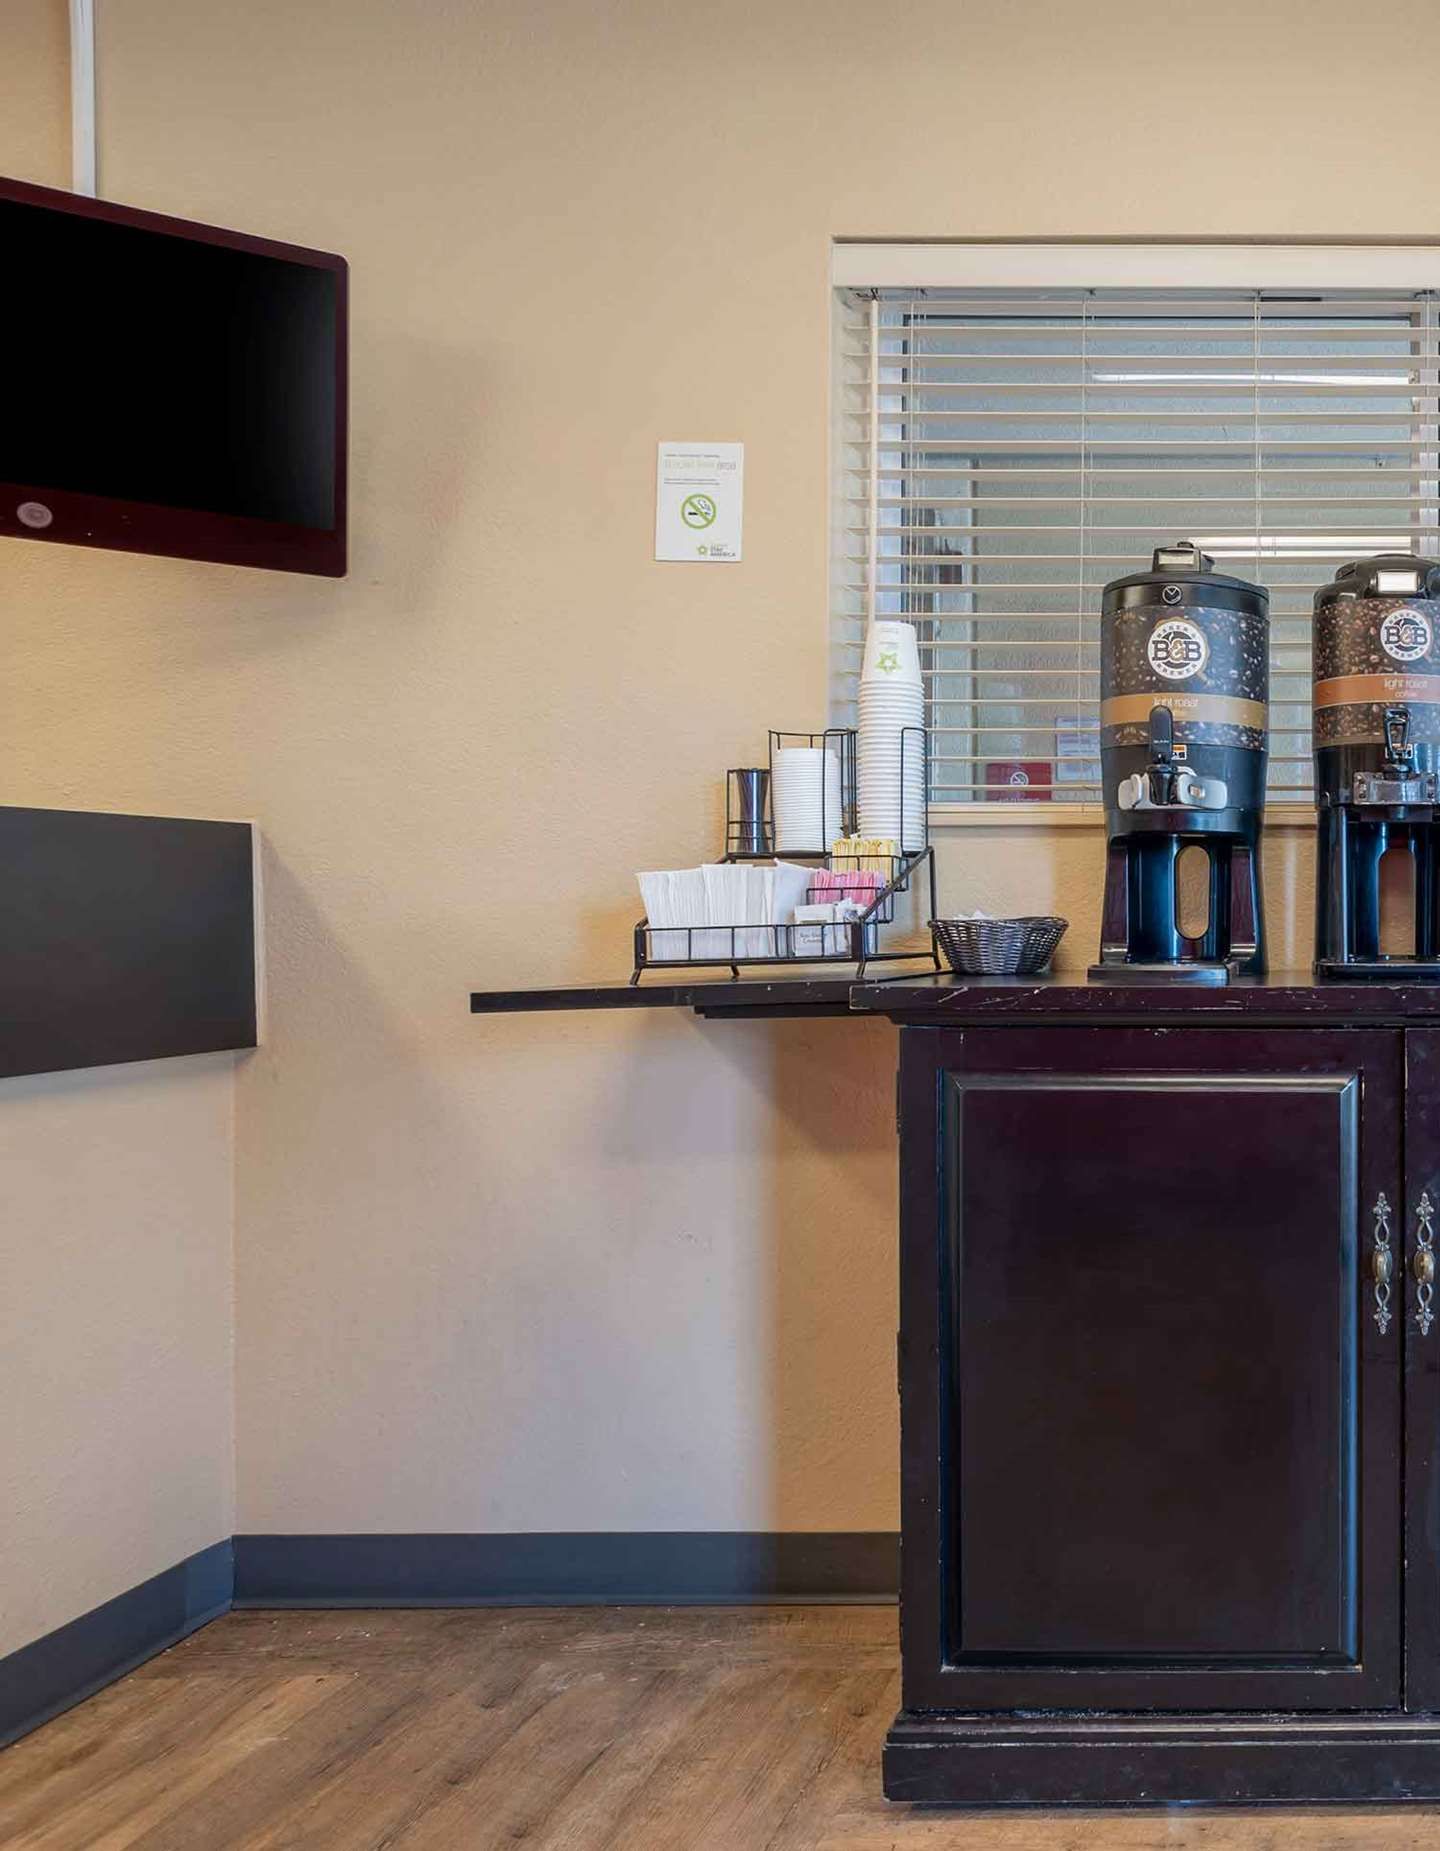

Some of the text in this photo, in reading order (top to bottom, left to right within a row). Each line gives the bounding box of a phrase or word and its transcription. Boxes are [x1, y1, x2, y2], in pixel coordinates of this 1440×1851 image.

[1384, 625, 1428, 646] B&B
[1152, 639, 1202, 662] B&B
[1384, 679, 1402, 690] light
